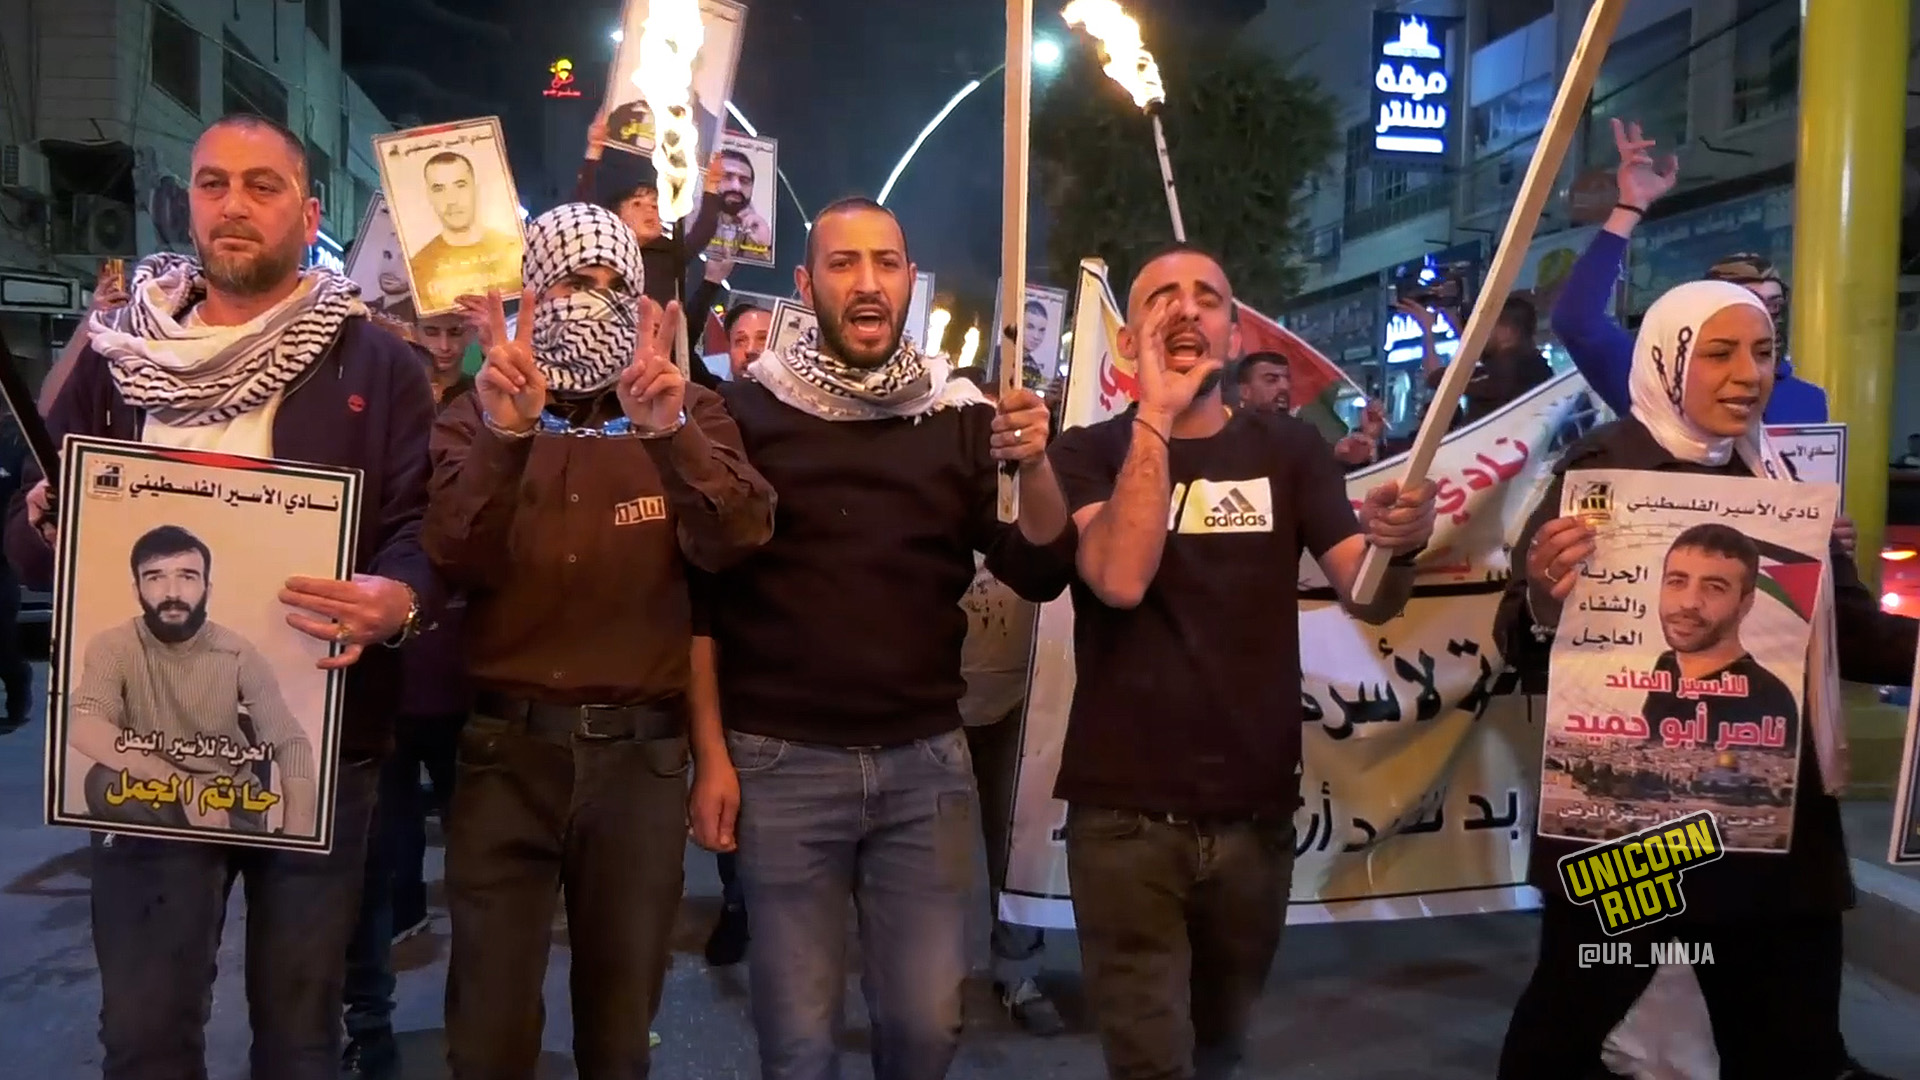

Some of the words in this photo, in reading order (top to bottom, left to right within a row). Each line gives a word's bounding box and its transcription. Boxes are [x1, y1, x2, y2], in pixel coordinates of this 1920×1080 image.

[1375, 99, 1446, 134] سنتر
[129, 474, 222, 498] الفلسطيني
[224, 480, 281, 507] الأسير
[1437, 437, 1529, 526] نادي
[284, 494, 340, 514] نادي
[1626, 496, 1719, 513] الفلسطيني
[1722, 499, 1777, 516] الأسير
[1780, 506, 1820, 521] نادي
[1204, 513, 1267, 527] adidas
[1580, 561, 1648, 584] الحرية
[1579, 596, 1646, 619] والشفاء
[1572, 627, 1642, 650] العاجل
[1605, 665, 1672, 692] القائد
[1677, 671, 1749, 699] للأسير
[1564, 713, 1650, 743] حميد
[1659, 702, 1708, 749] أبو
[1715, 715, 1787, 750] ناصر
[116, 729, 163, 756] البطل
[168, 731, 217, 760] للأسير
[220, 735, 273, 764] الحرية
[105, 768, 194, 809] الجمل
[199, 776, 281, 816] حاتم
[1558, 802, 1604, 820] المرض
